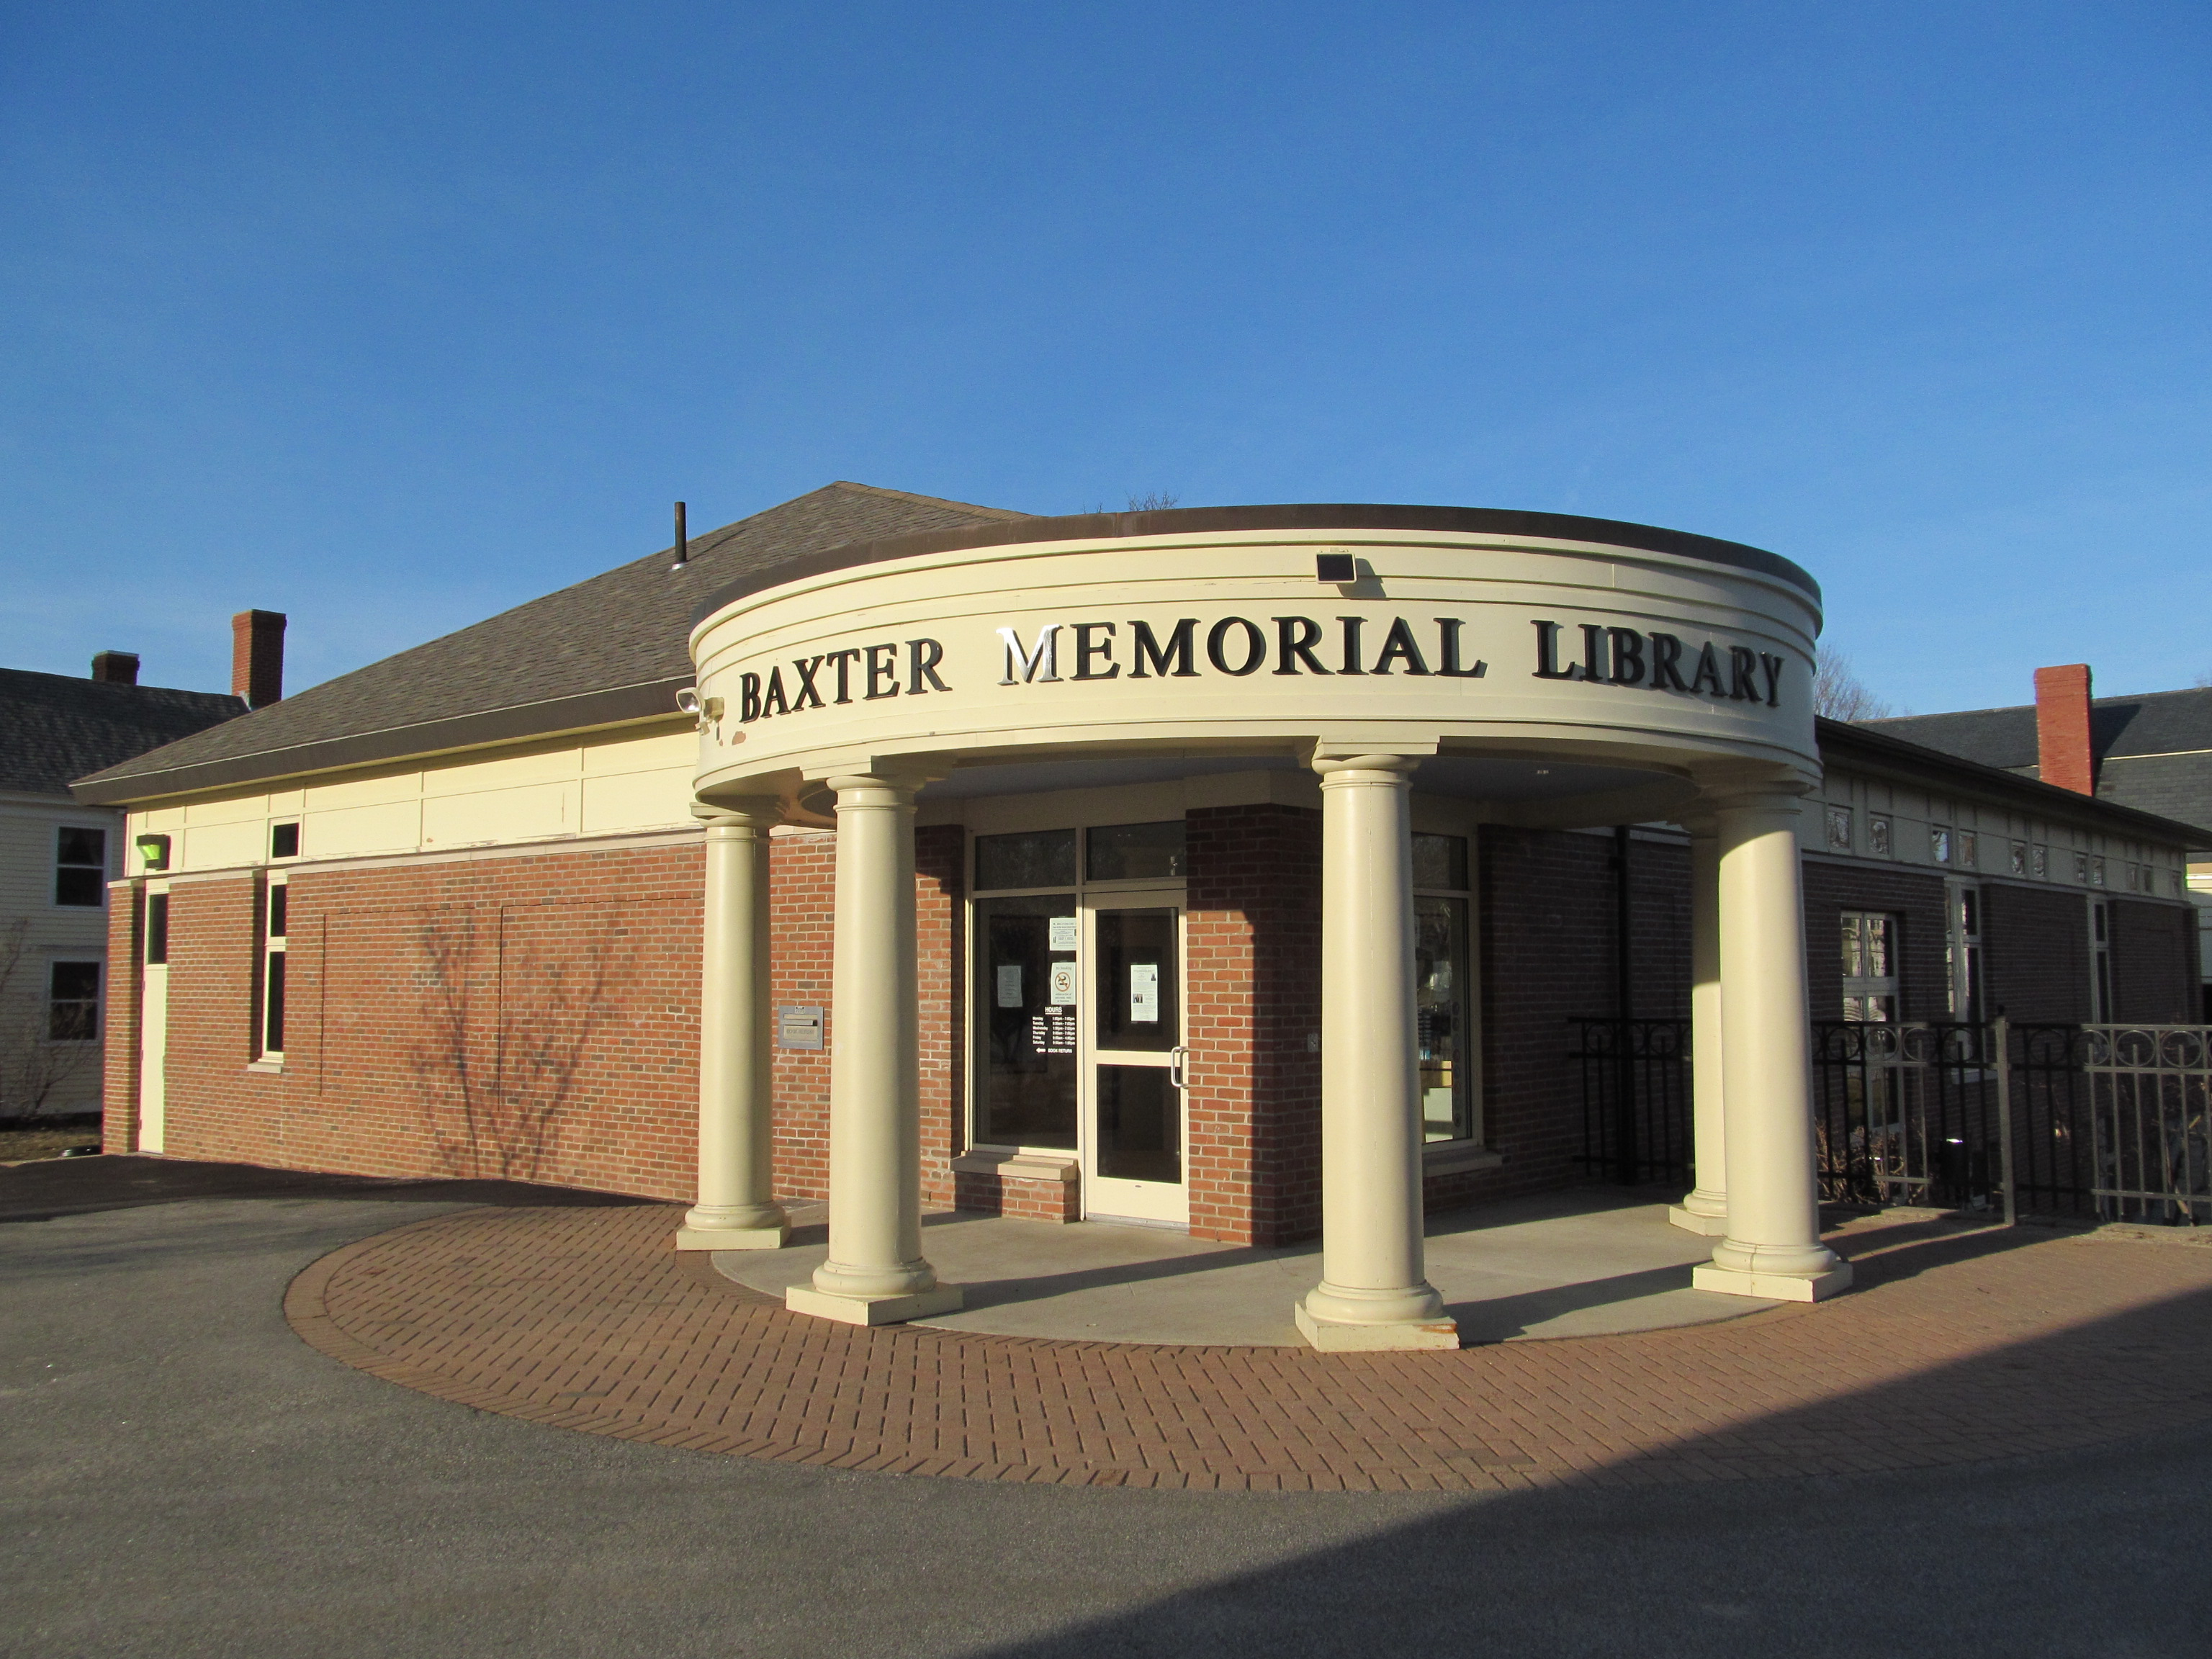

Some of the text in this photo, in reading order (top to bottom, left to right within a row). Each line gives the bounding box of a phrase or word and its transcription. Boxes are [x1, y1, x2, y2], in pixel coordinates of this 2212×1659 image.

[739, 616, 1785, 723] BAXTER MEMORIAL LIBRARY
